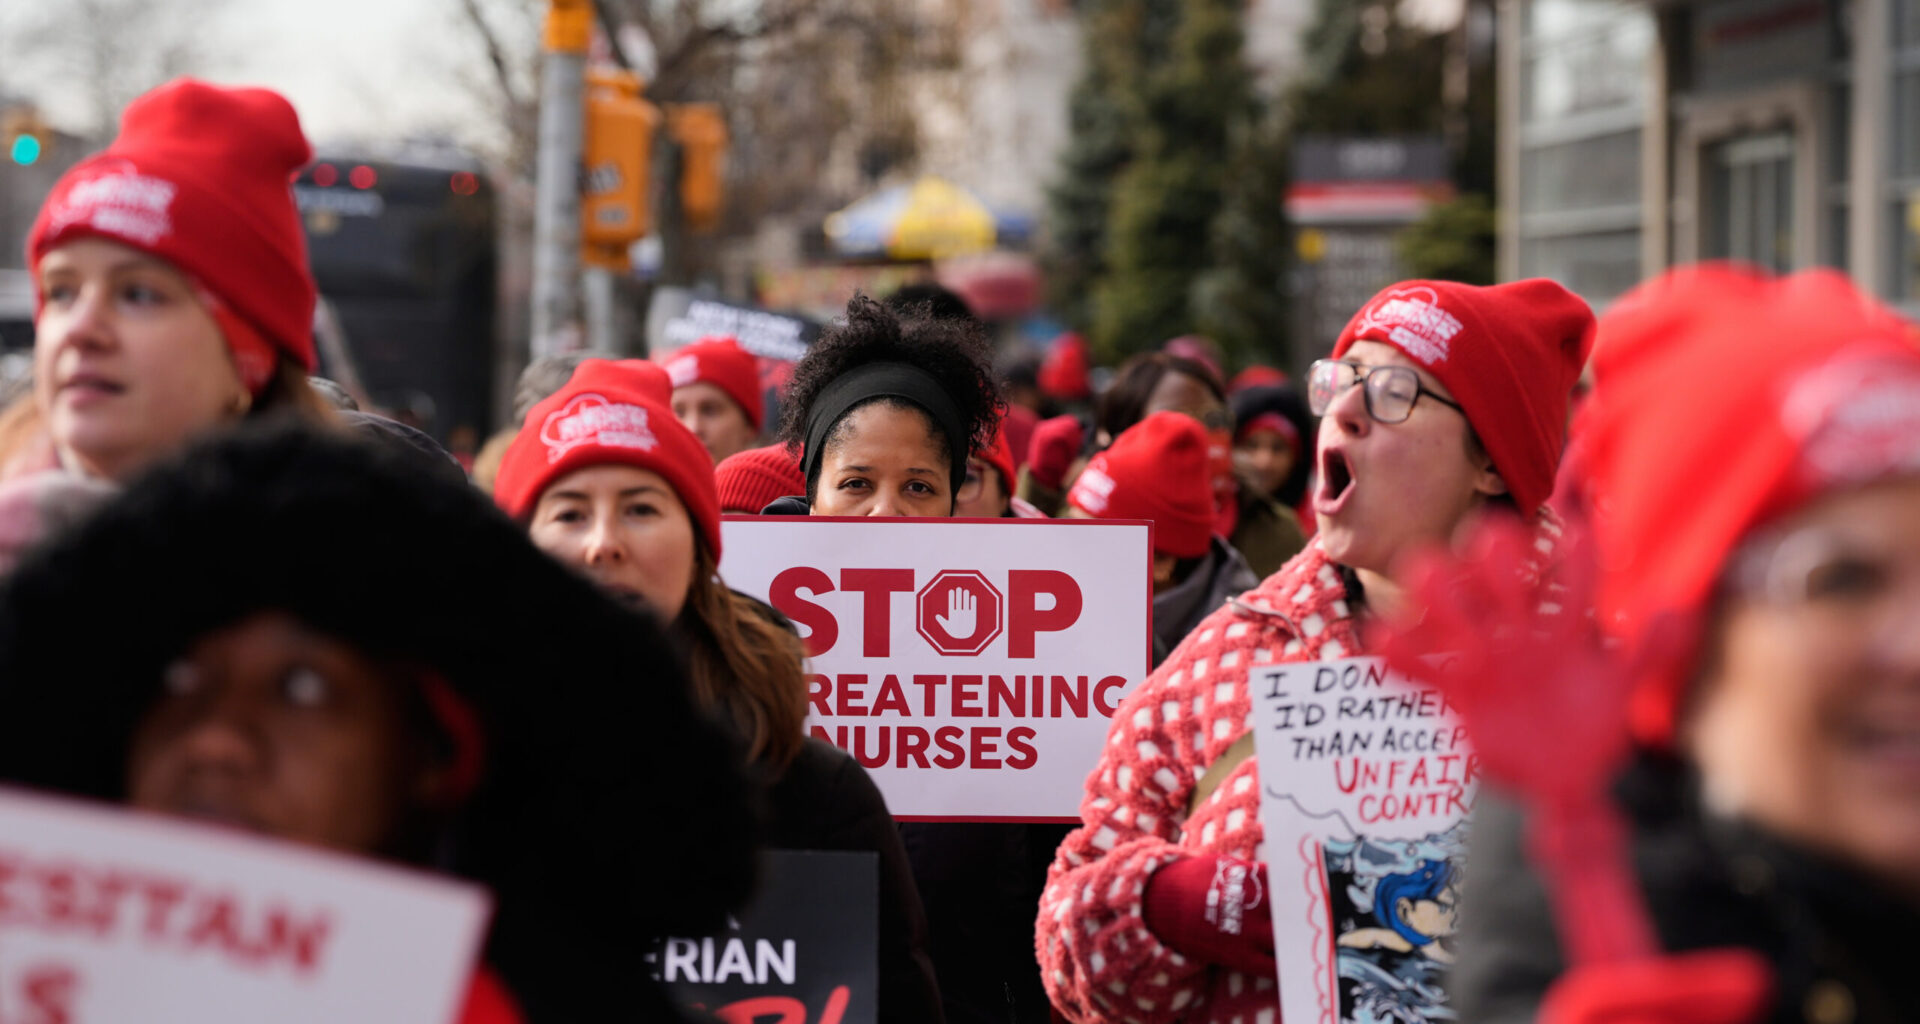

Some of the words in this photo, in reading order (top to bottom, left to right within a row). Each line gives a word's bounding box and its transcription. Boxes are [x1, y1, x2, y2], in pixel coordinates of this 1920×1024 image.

[769, 566, 1083, 658] STOP
[801, 673, 1128, 718] REATENING
[1265, 672, 1289, 700] I
[1275, 703, 1326, 730] I'D
[810, 725, 1038, 770] NURSES
[1292, 731, 1373, 760] THAN
[1381, 727, 1469, 753] ACCEP
[1334, 753, 1482, 795] UNFAIR
[1358, 783, 1479, 824] CONTR
